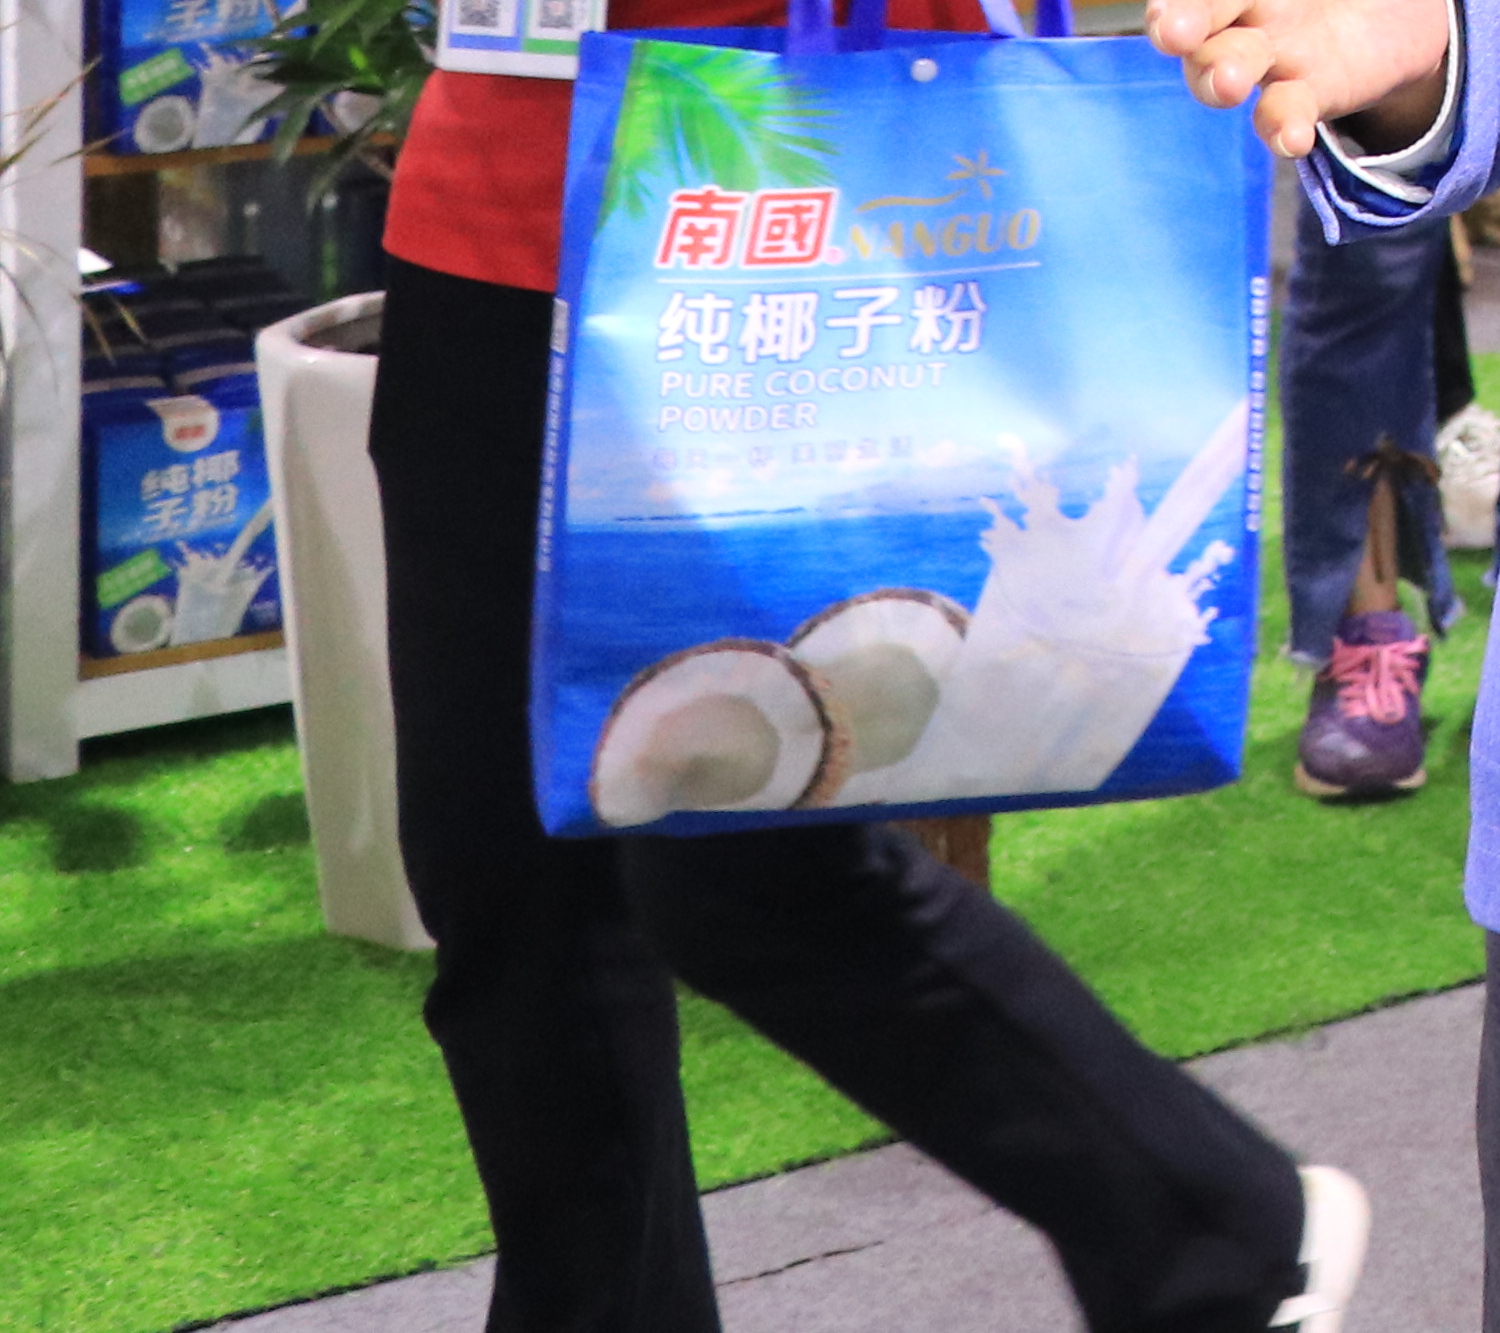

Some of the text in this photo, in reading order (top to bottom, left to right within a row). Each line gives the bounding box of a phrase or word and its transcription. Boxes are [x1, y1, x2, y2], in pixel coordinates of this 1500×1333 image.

[849, 208, 1041, 260] NANGUO
[655, 280, 988, 365] 纯椰子粉
[659, 362, 949, 399] PURE COCONUT
[657, 401, 818, 433] POWDER
